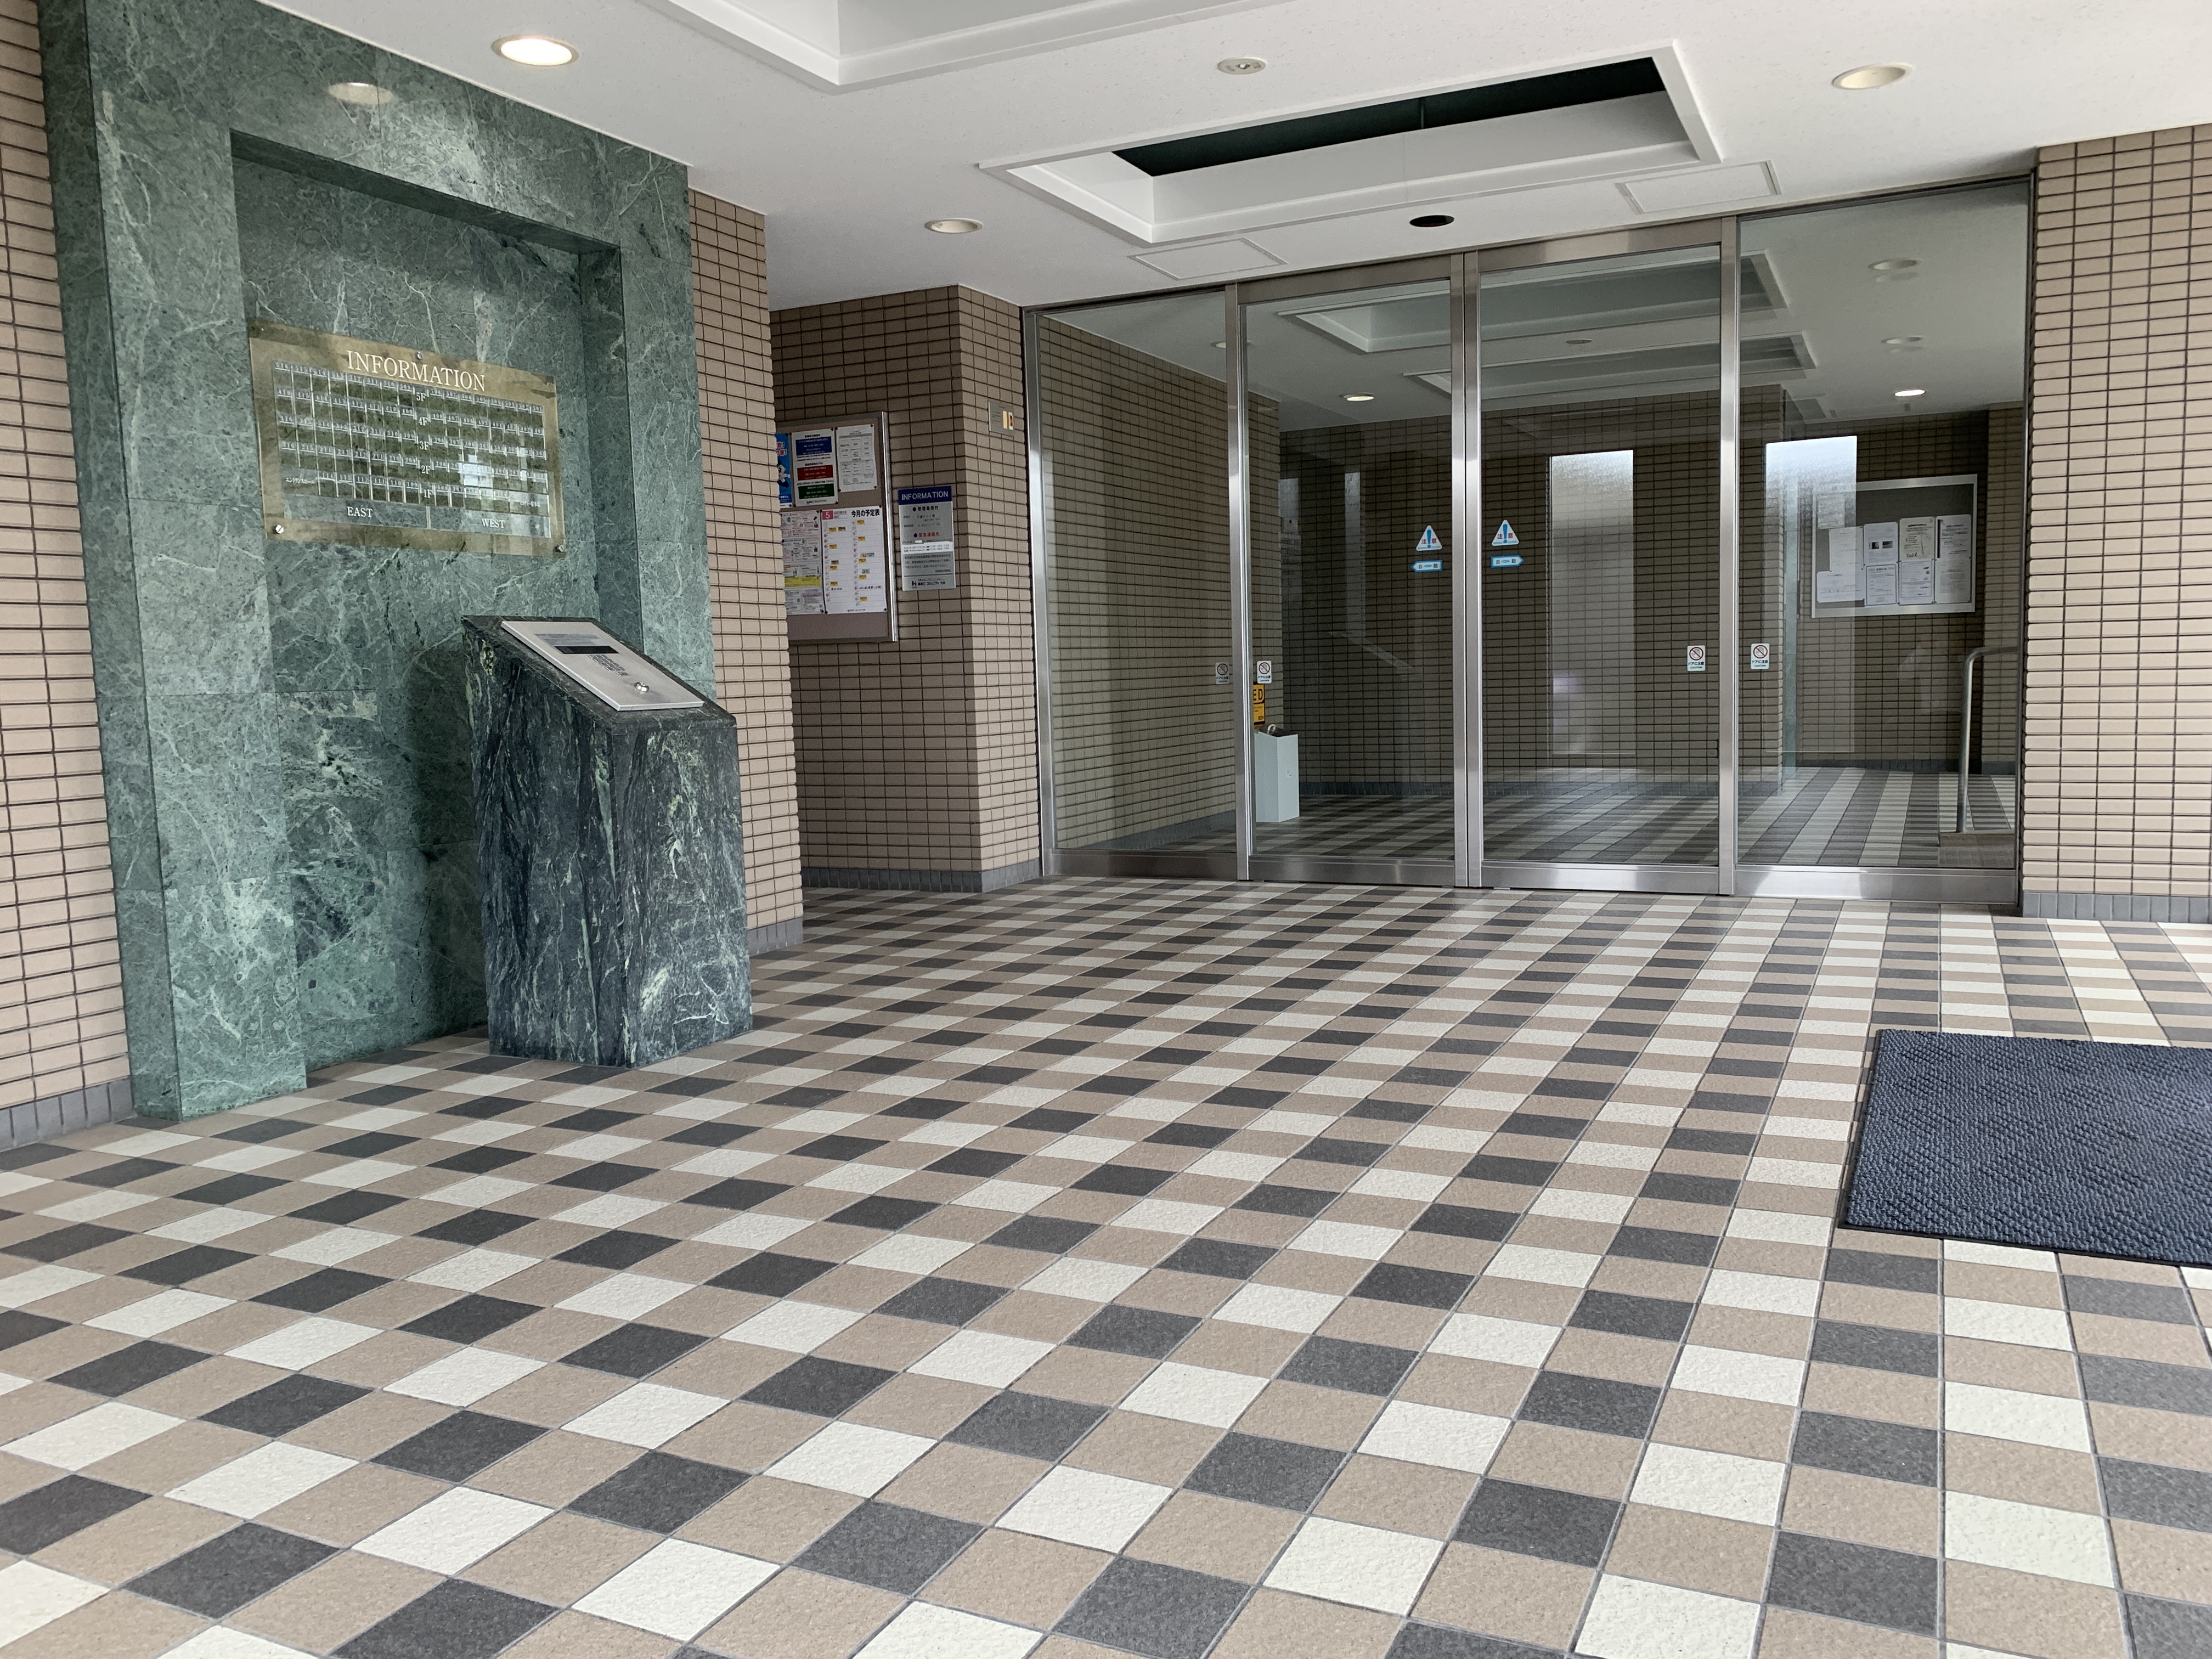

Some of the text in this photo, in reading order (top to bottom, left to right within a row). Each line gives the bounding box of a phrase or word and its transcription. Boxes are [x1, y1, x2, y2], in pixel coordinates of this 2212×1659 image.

[346, 350, 485, 392] INFORMATION
[416, 392, 426, 402] 5F
[418, 416, 428, 426] 4F
[419, 441, 430, 450] 3F
[421, 465, 431, 475] 2F
[423, 489, 433, 498] 1F
[901, 490, 949, 500] INFORMATION
[347, 506, 373, 518] EAST
[851, 509, 880, 517] 今月の予定表
[482, 518, 505, 528] WEST
